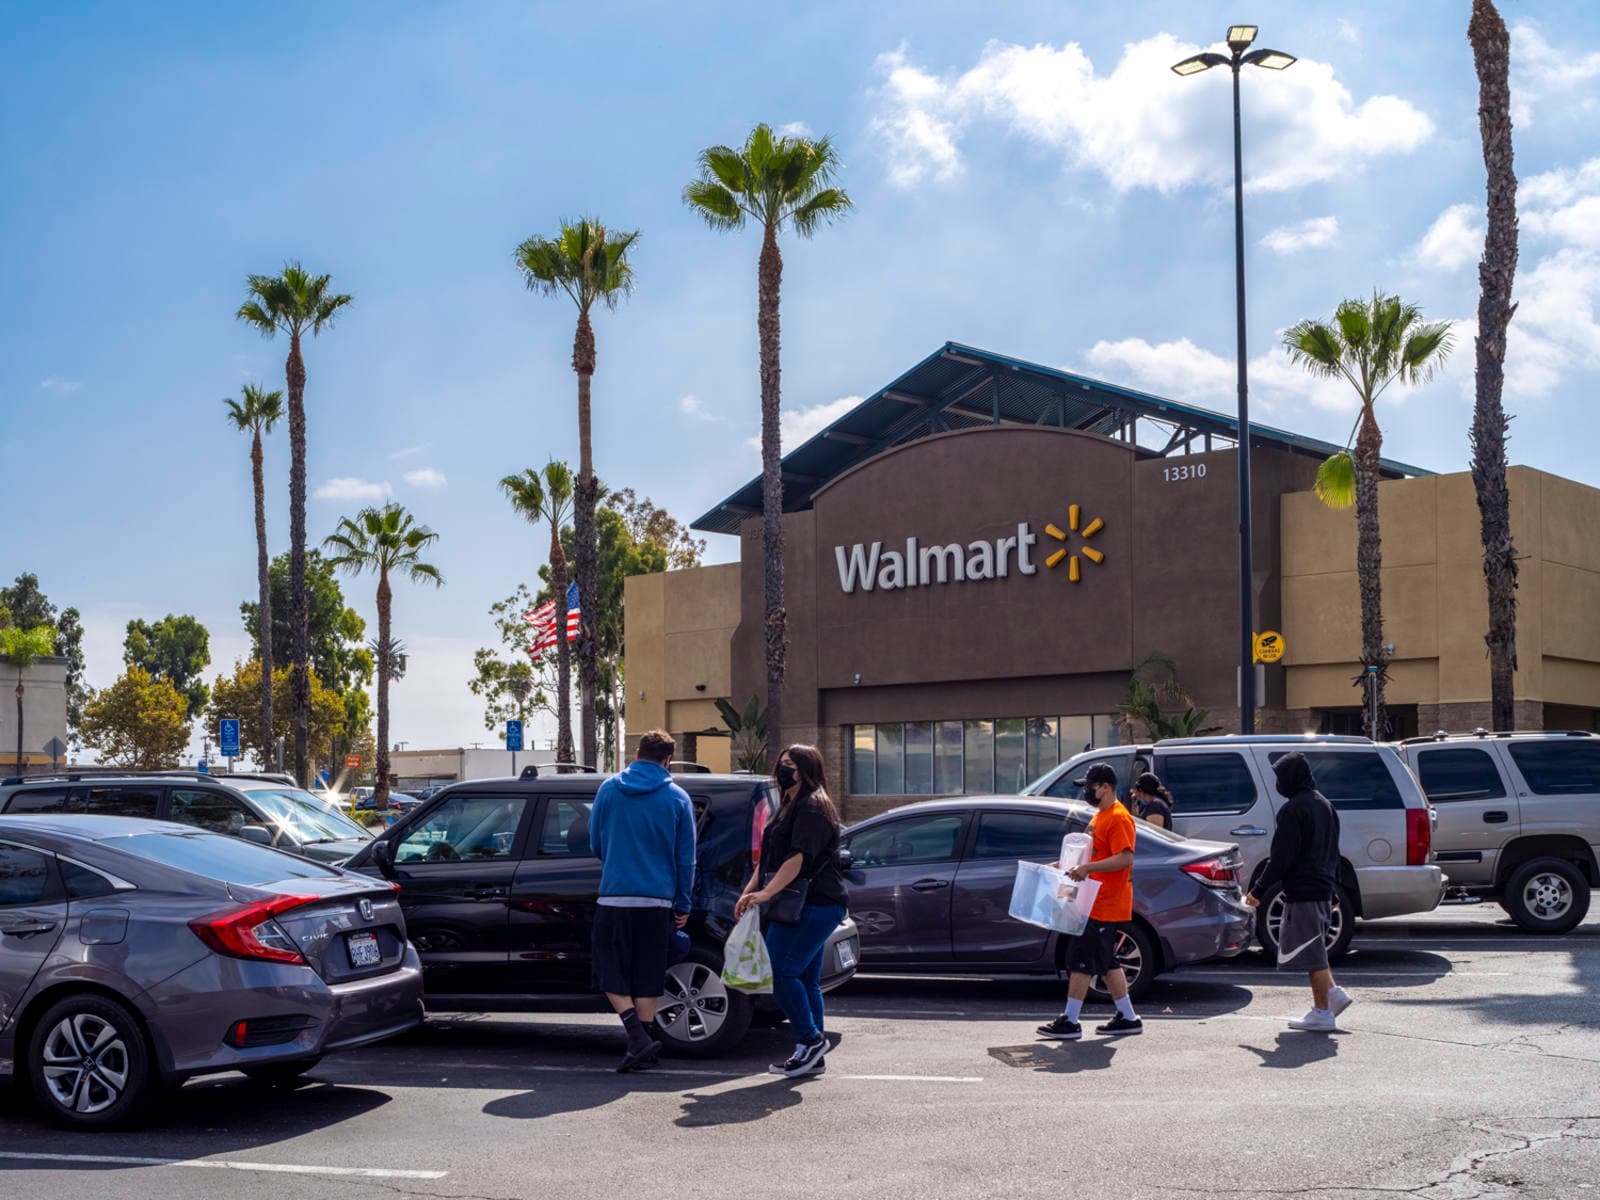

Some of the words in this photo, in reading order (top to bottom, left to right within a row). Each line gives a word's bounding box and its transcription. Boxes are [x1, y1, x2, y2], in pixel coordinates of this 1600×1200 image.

[1163, 463, 1207, 482] 13310
[834, 522, 1037, 593] Walmart
[302, 933, 329, 942] CIVIC
